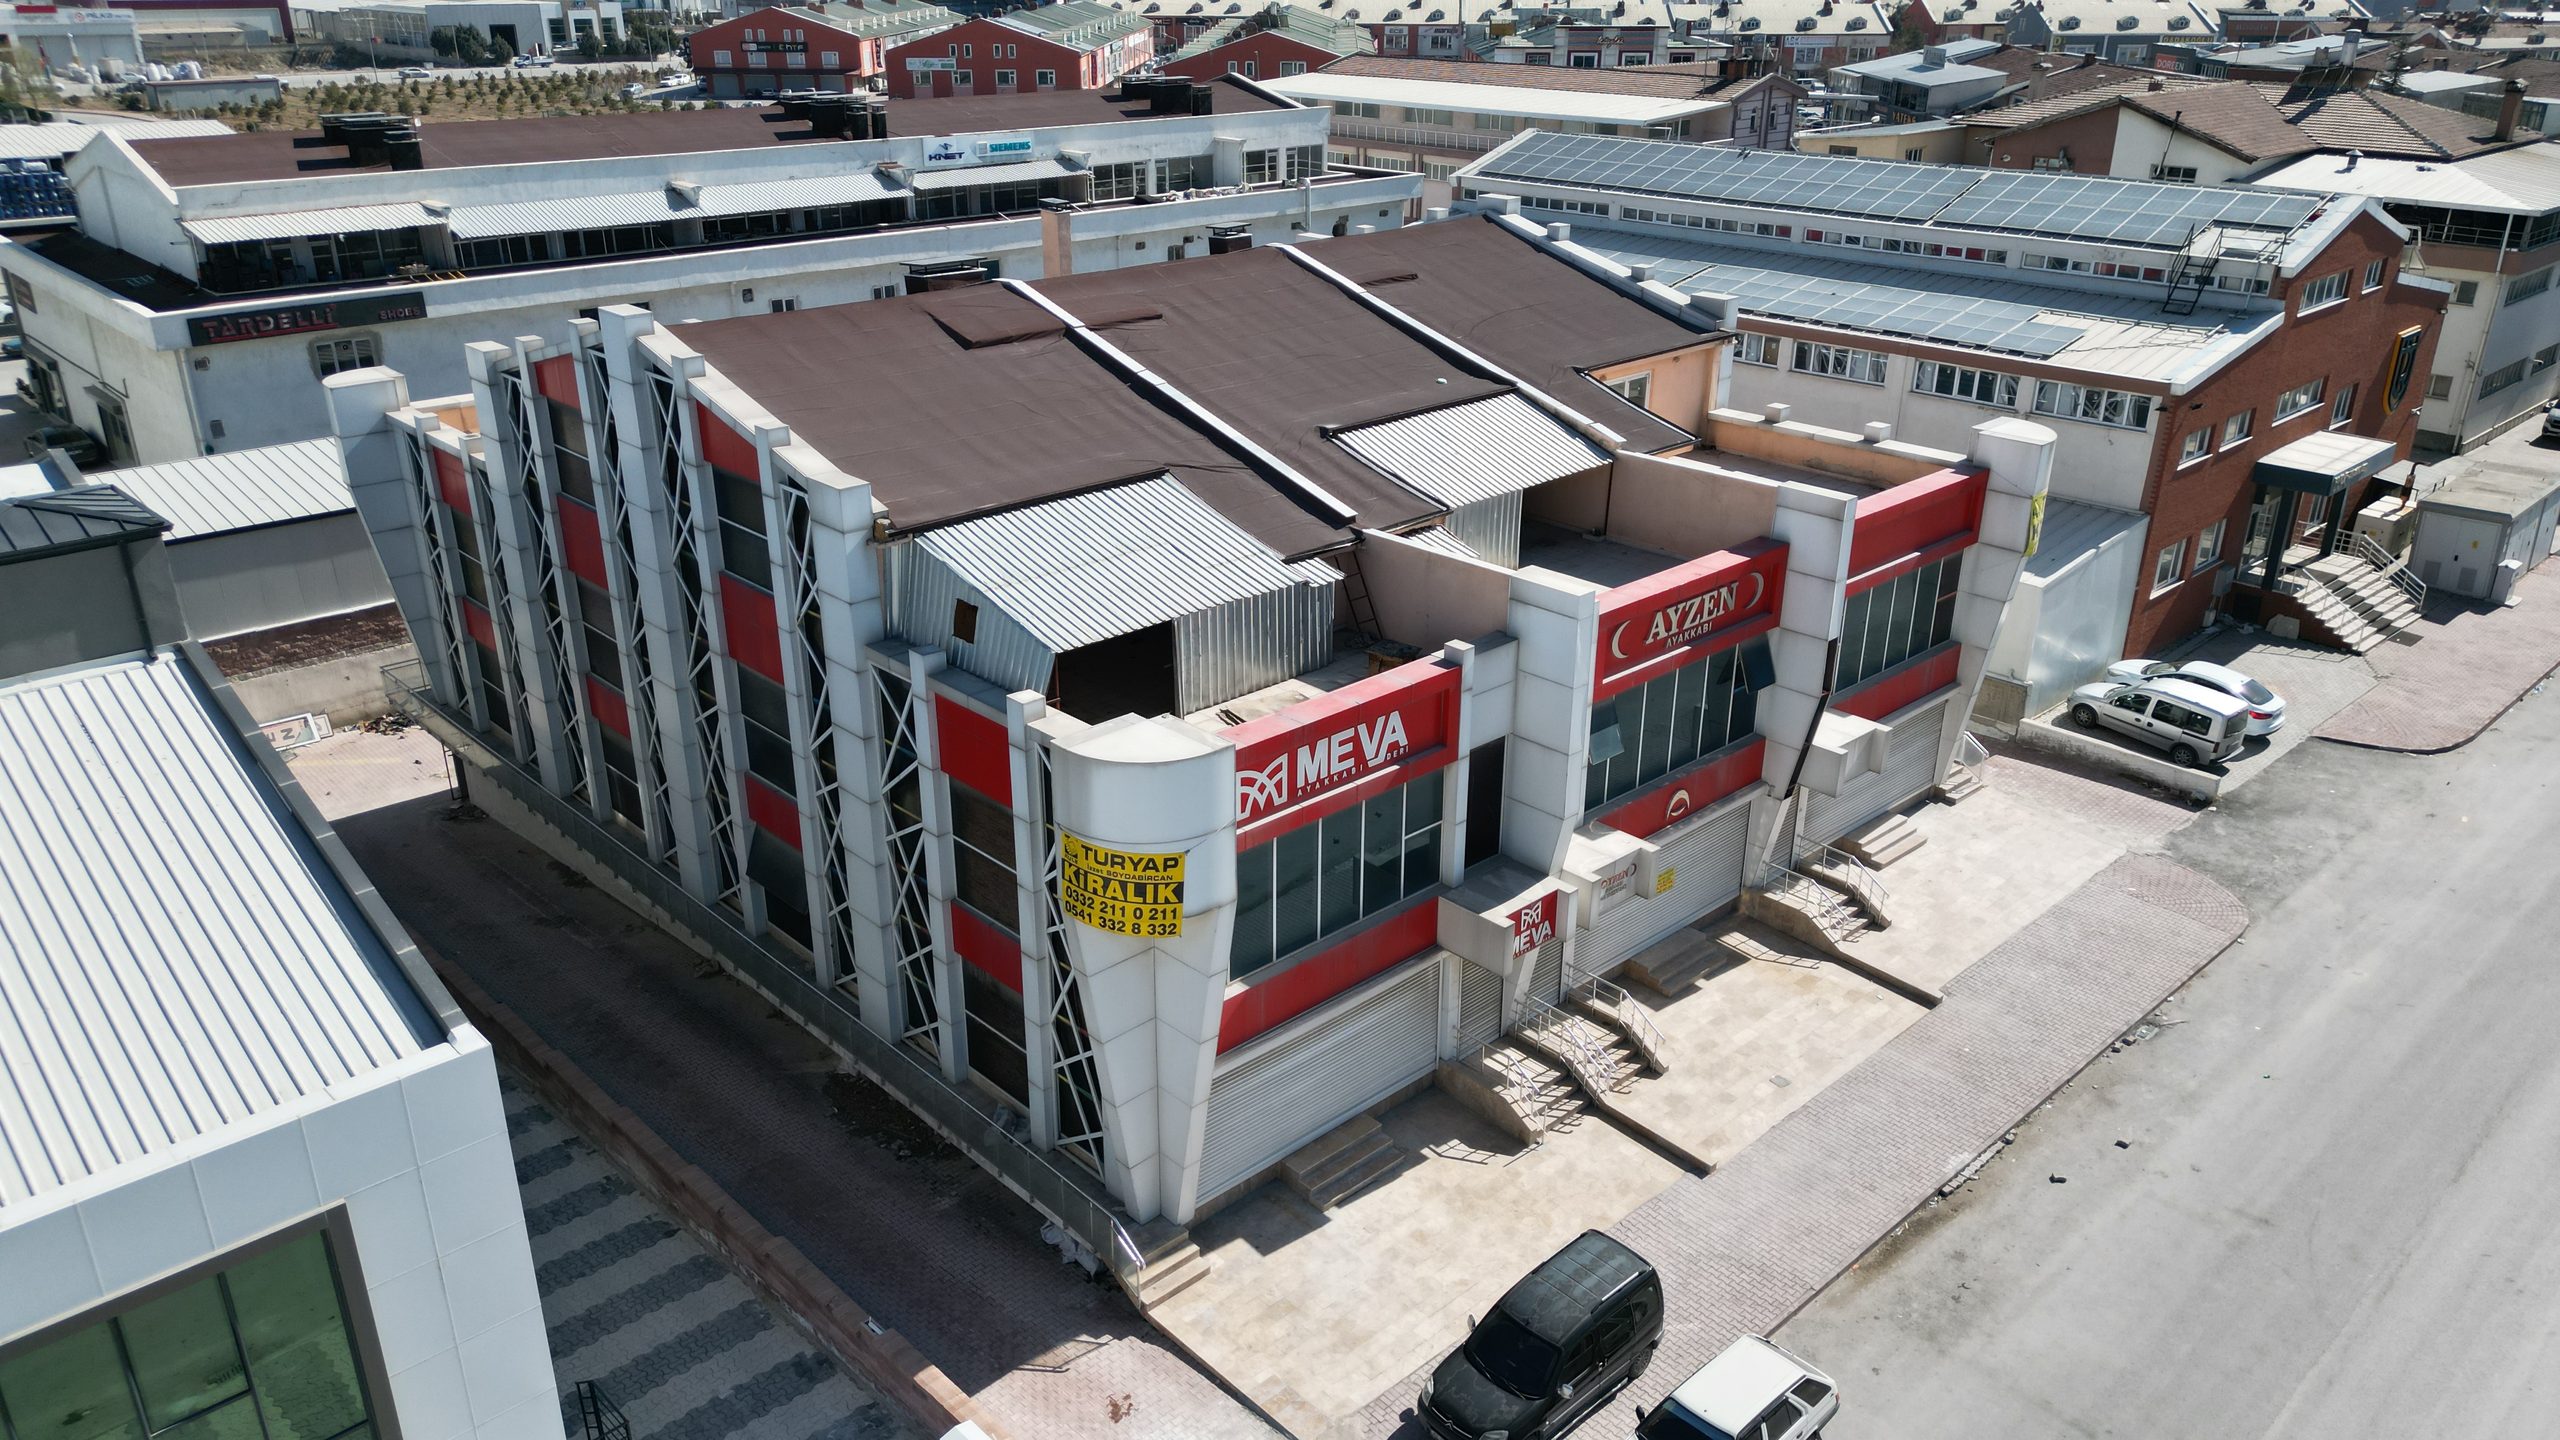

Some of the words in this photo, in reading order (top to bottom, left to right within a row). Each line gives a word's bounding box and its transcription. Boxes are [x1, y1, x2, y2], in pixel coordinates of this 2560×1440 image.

[2157, 58, 2185, 72] DOREEN
[928, 152, 965, 161] KNET
[989, 141, 1032, 153] SIEMENS
[379, 306, 421, 320] SHOES
[1645, 581, 1740, 645] AYZEN
[1666, 621, 1713, 649] AYAKKABI
[1297, 710, 1409, 788] MEVA
[1297, 763, 1364, 797] AYAKKABI
[1080, 843, 1180, 873] TURYAP
[1063, 860, 1180, 905] KİRALIK
[1065, 885, 1096, 910] 0332
[1099, 900, 1127, 918] 211
[1132, 907, 1144, 920] 0
[1148, 907, 1178, 921] 211
[1065, 900, 1093, 923] 0541
[1098, 916, 1127, 933] 332
[1131, 922, 1142, 935] 8
[1147, 922, 1178, 936] 332
[1513, 919, 1552, 955] MEVA
